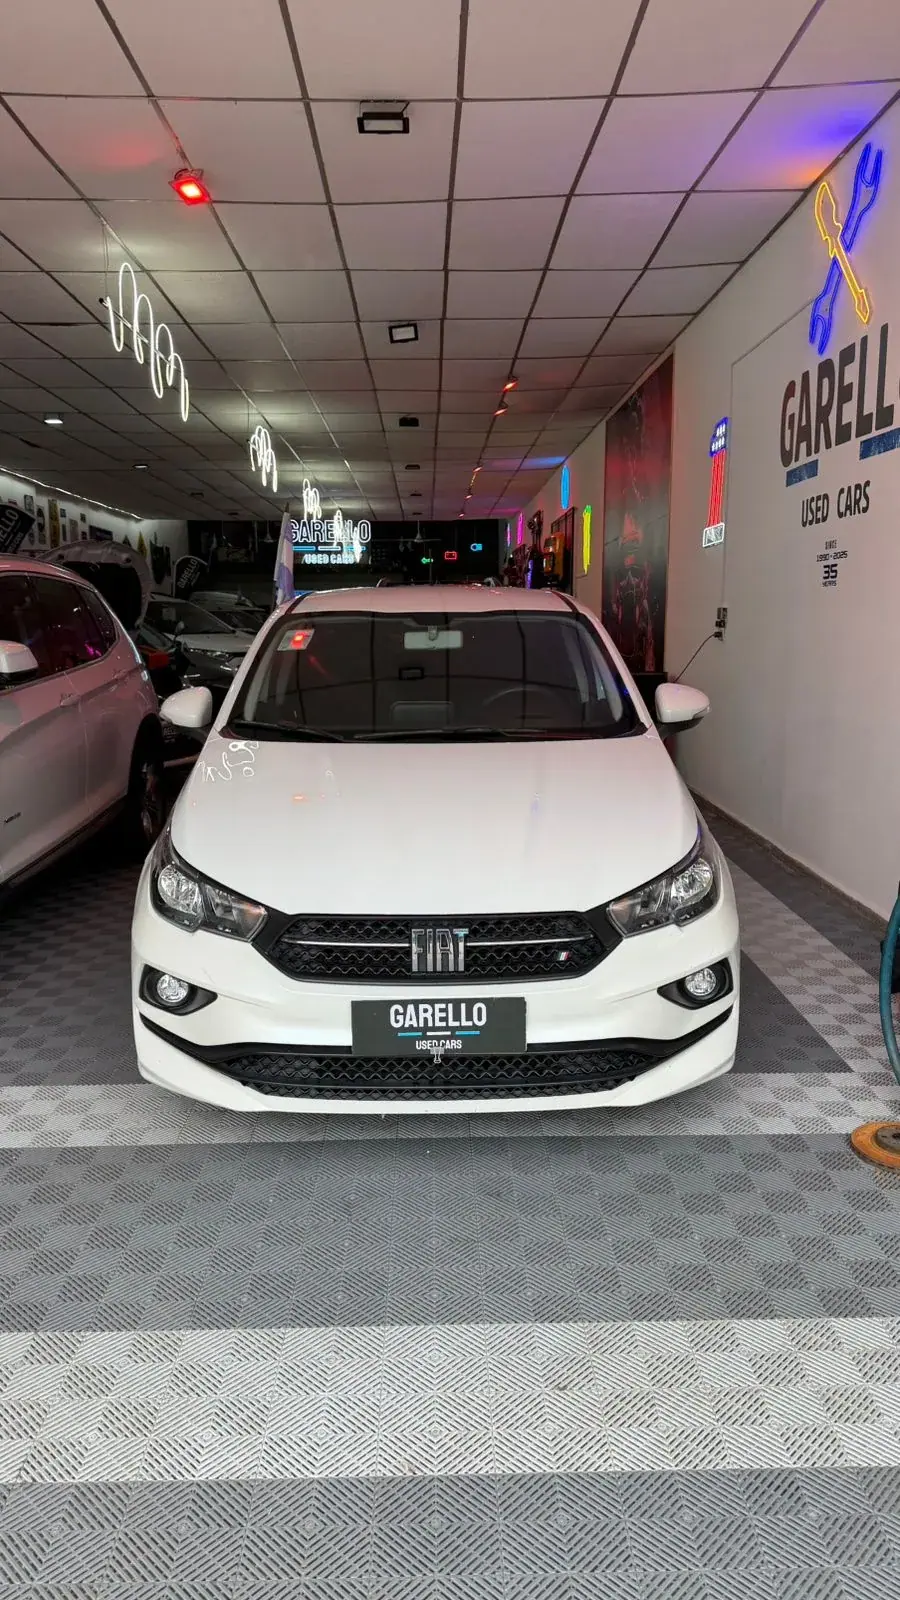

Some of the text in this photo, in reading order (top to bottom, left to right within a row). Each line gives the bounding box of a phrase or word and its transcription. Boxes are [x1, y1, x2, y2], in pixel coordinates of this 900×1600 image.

[780, 322, 900, 468] GARELL
[801, 480, 871, 527] USED CARS
[0, 509, 19, 542] ELLO
[304, 553, 355, 564] USED CARS
[823, 563, 838, 580] 35
[412, 928, 469, 971] FIAT
[389, 1002, 487, 1028] GARELLO
[415, 1039, 462, 1050] USED CARS
